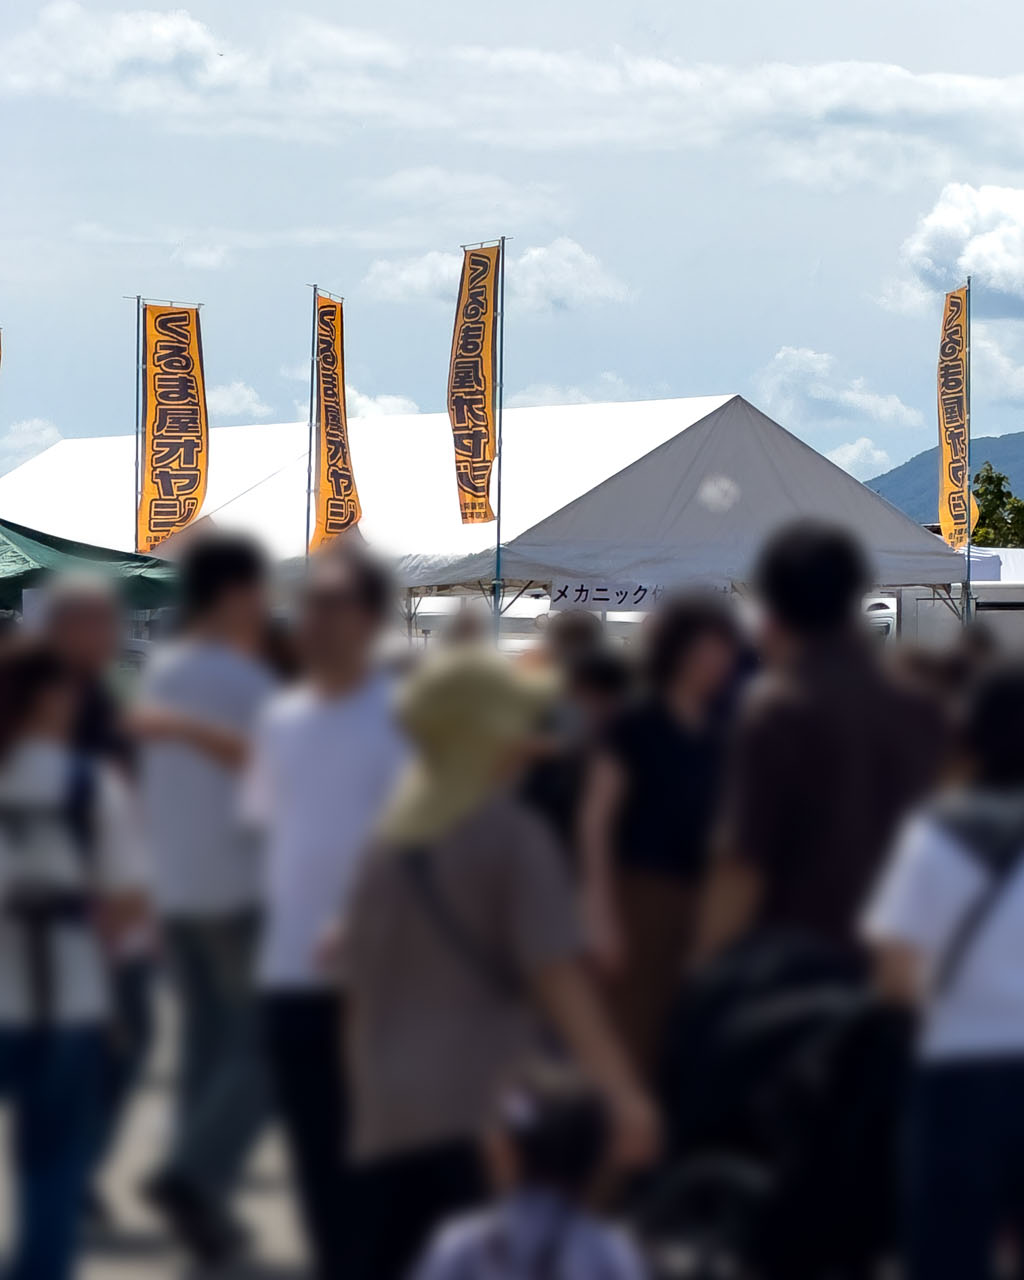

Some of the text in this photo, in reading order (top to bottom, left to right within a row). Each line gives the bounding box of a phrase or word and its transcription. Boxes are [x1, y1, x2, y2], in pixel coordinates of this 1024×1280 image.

[148, 311, 202, 532] くるま屋オヤジ
